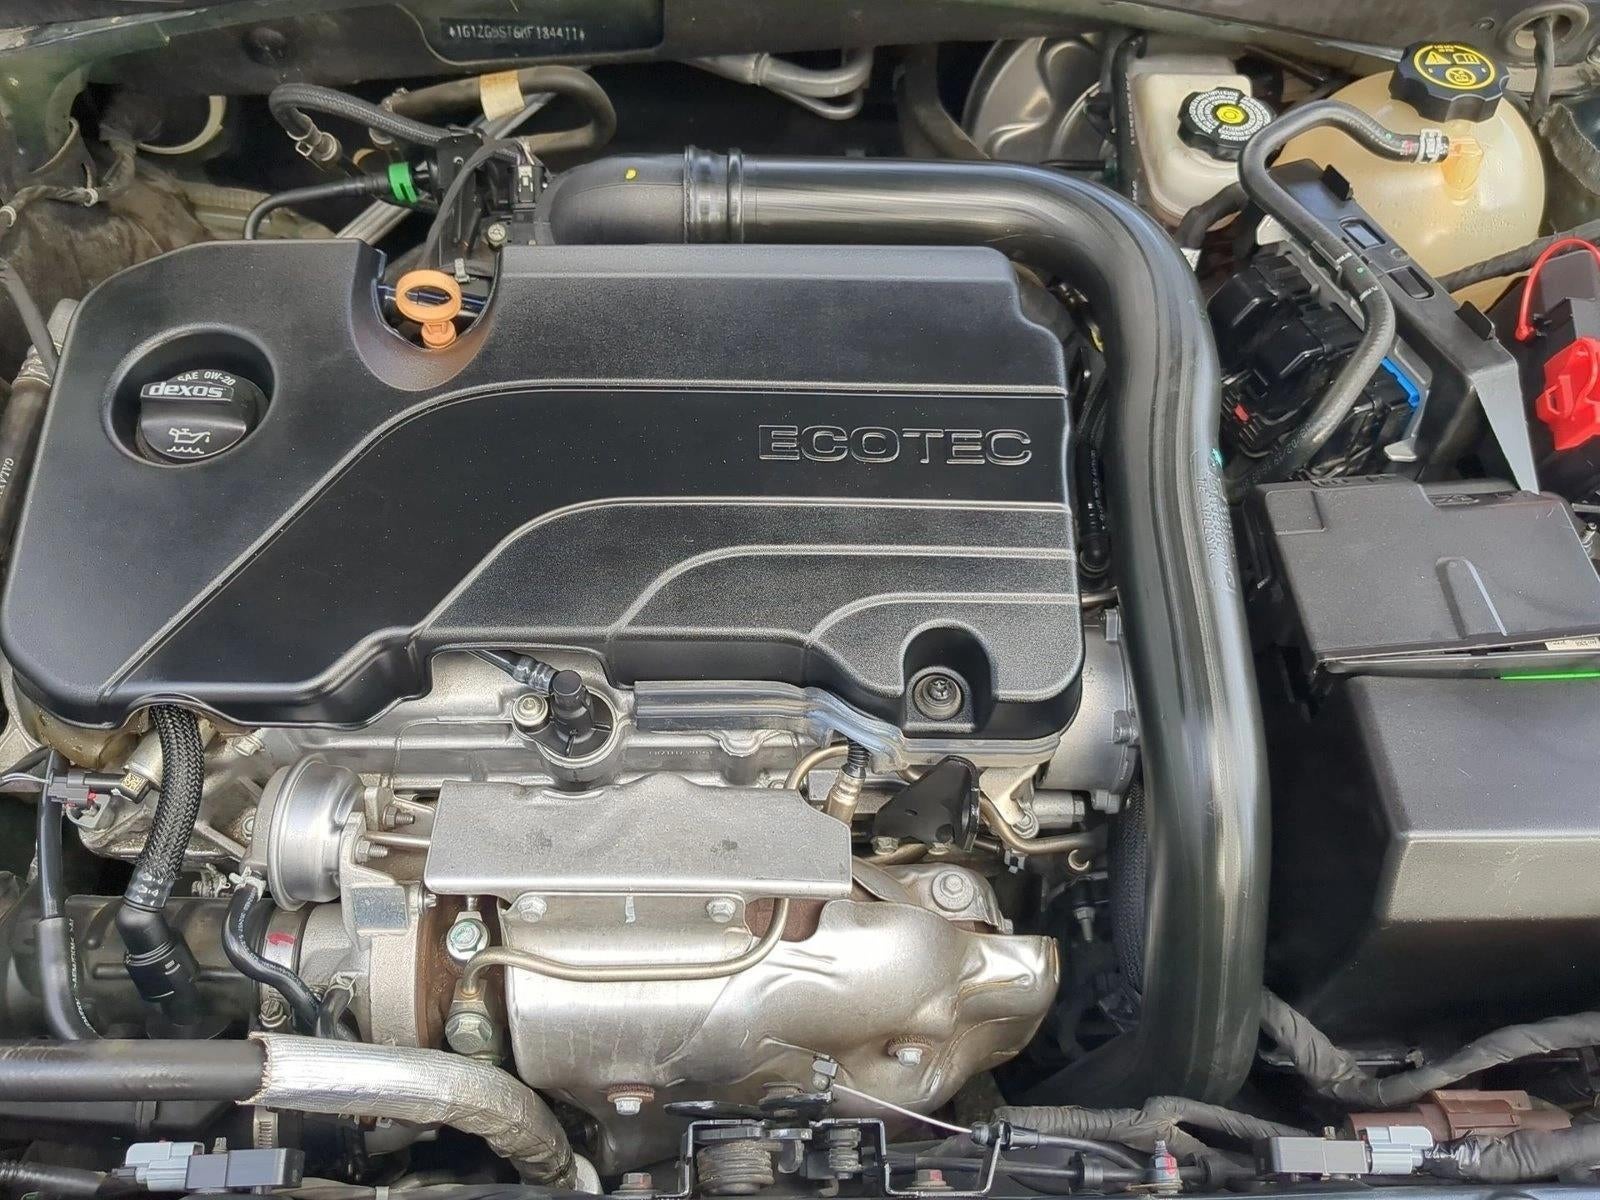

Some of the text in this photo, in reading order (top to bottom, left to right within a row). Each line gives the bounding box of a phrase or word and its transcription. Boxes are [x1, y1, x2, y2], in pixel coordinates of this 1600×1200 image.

[177, 370, 237, 387] SAE 0W-20
[148, 382, 224, 398] dexos
[758, 424, 1033, 466] ECOTEC
